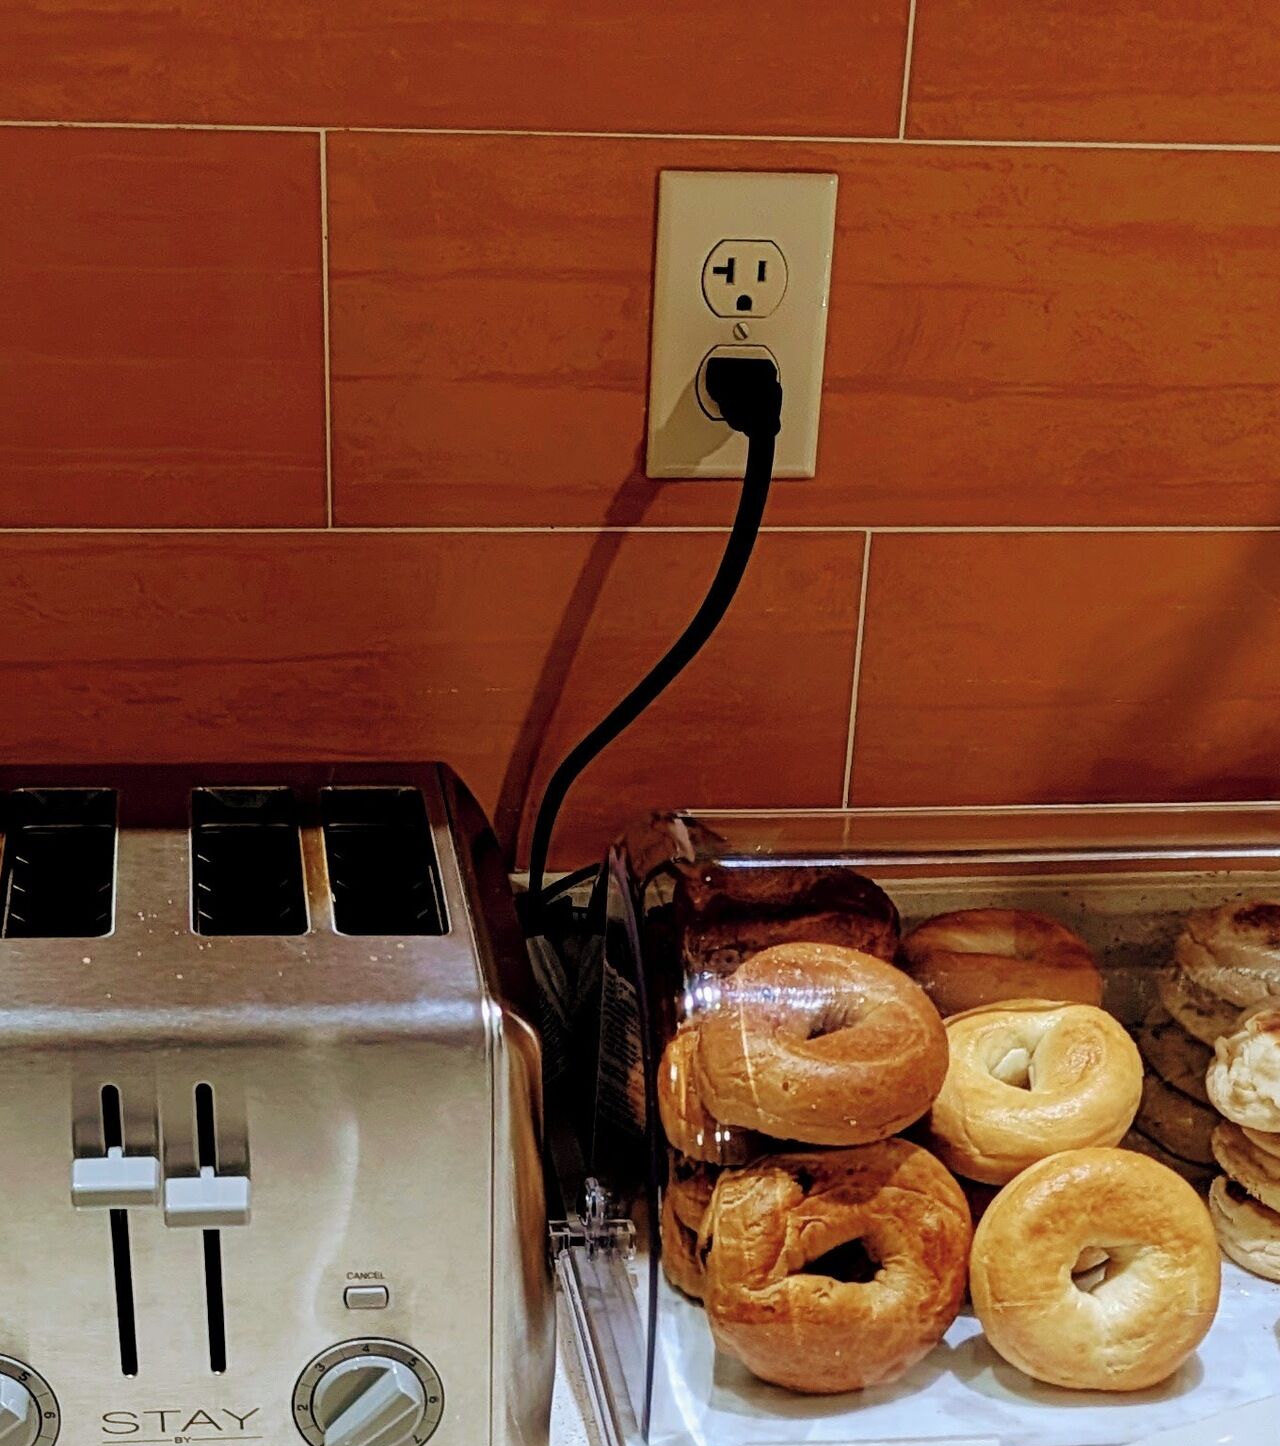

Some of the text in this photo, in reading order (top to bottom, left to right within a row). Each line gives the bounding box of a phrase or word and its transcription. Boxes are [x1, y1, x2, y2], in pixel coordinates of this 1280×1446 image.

[346, 1271, 385, 1281] CANCEL
[297, 1403, 309, 1412] 2
[314, 1362, 326, 1373] 3
[362, 1344, 371, 1353] 4
[408, 1357, 420, 1367] 5
[18, 1371, 32, 1382] 5
[43, 1410, 57, 1420] 6
[102, 1407, 260, 1435] STAY
[173, 1436, 192, 1445] BY
